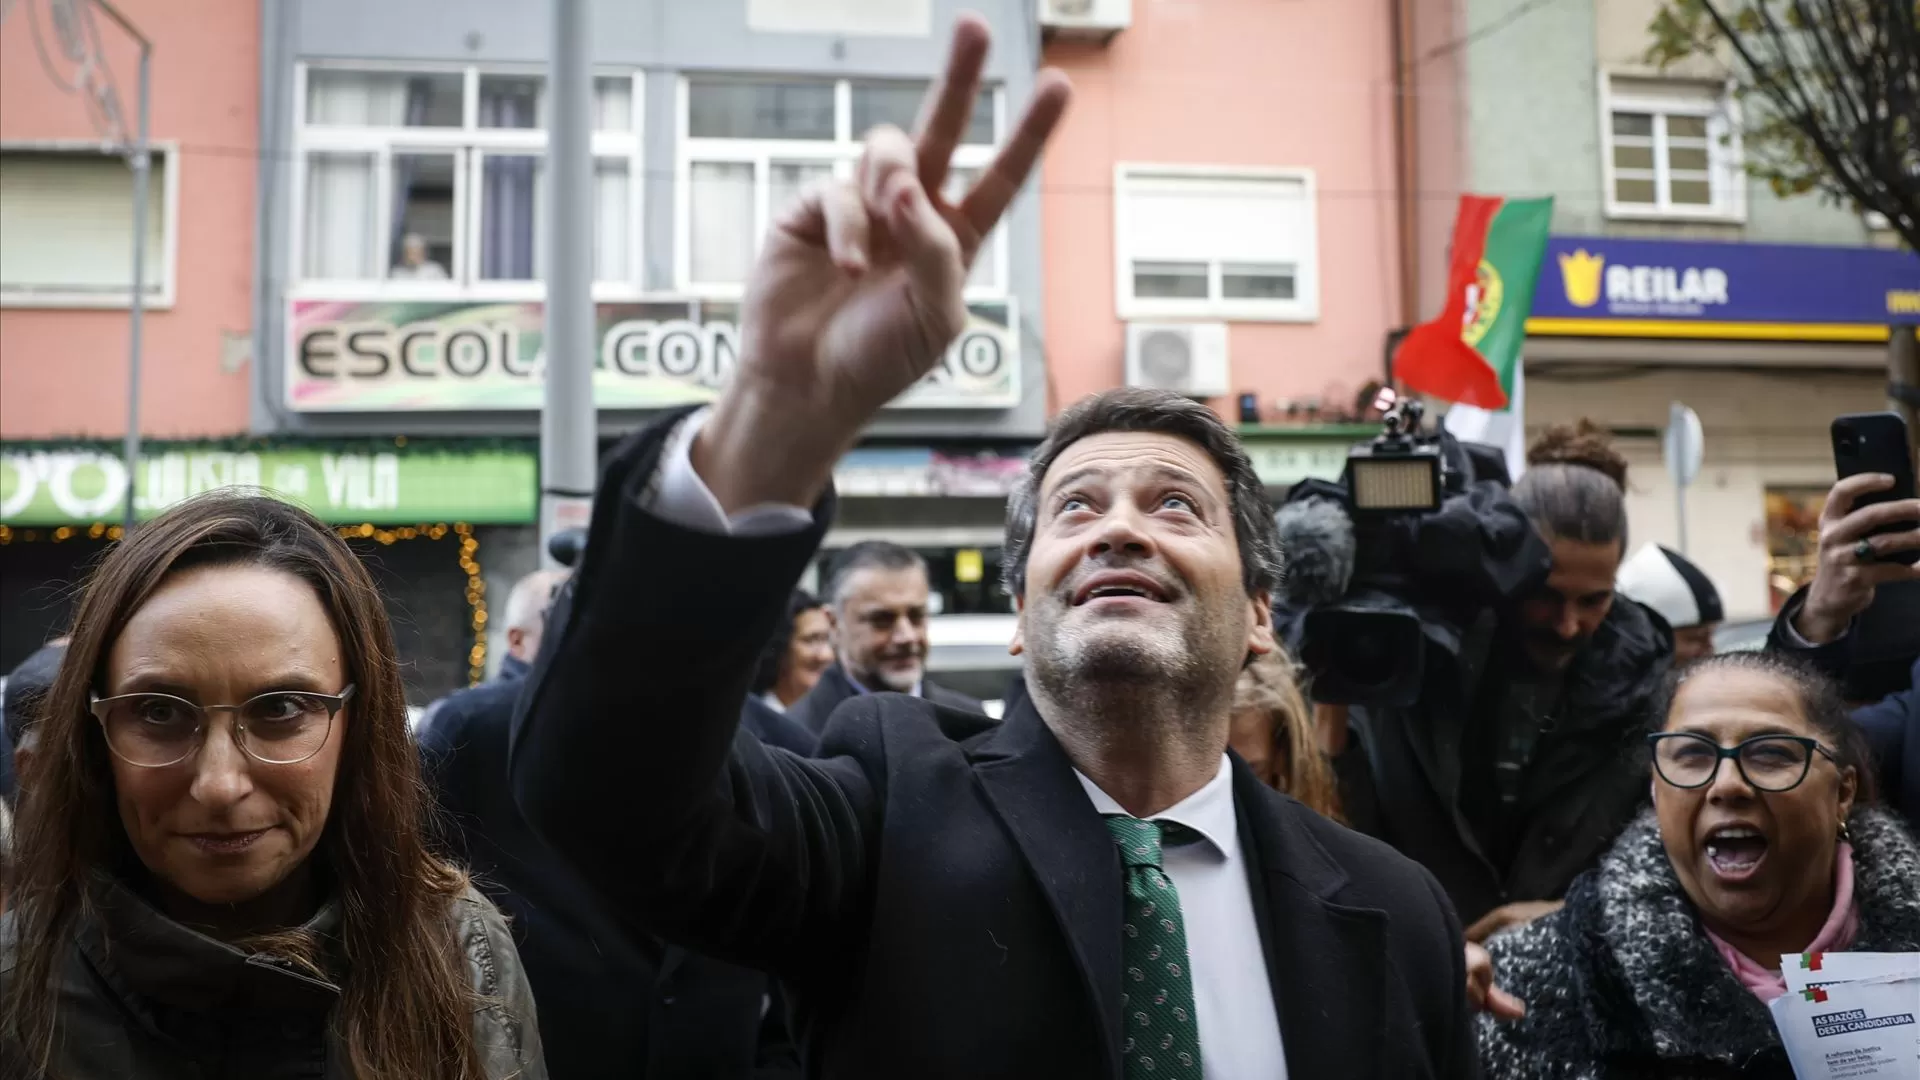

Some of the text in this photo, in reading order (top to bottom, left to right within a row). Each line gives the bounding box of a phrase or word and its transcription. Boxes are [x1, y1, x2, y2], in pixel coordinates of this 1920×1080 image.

[1606, 264, 1729, 305] REILAR
[300, 328, 546, 381] ESCOL
[1815, 1010, 1864, 1026] AS RAZÕES
[1817, 1015, 1913, 1036] DESTA CANDIDATURA
